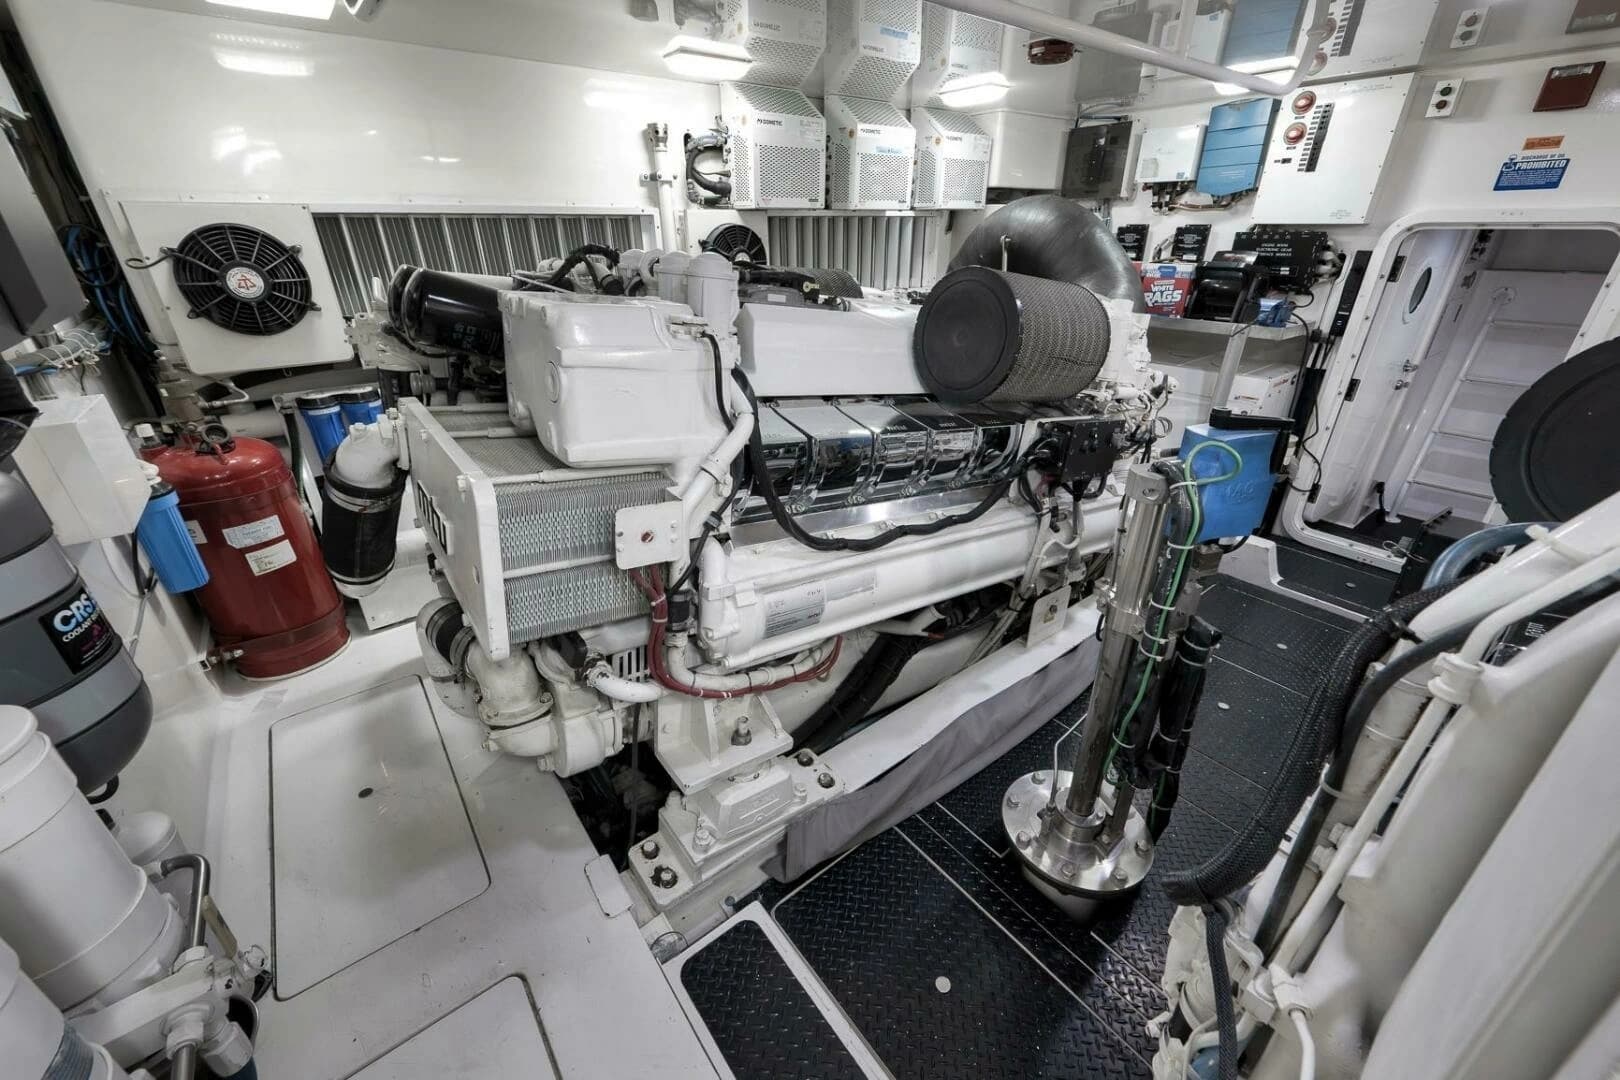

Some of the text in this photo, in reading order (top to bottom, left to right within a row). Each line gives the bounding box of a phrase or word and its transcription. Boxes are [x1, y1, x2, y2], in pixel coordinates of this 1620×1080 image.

[1515, 160, 1567, 170] PROHIBITED
[1151, 284, 1175, 292] WHITE
[1144, 290, 1183, 307] RAGS
[53, 593, 95, 632] CRS
